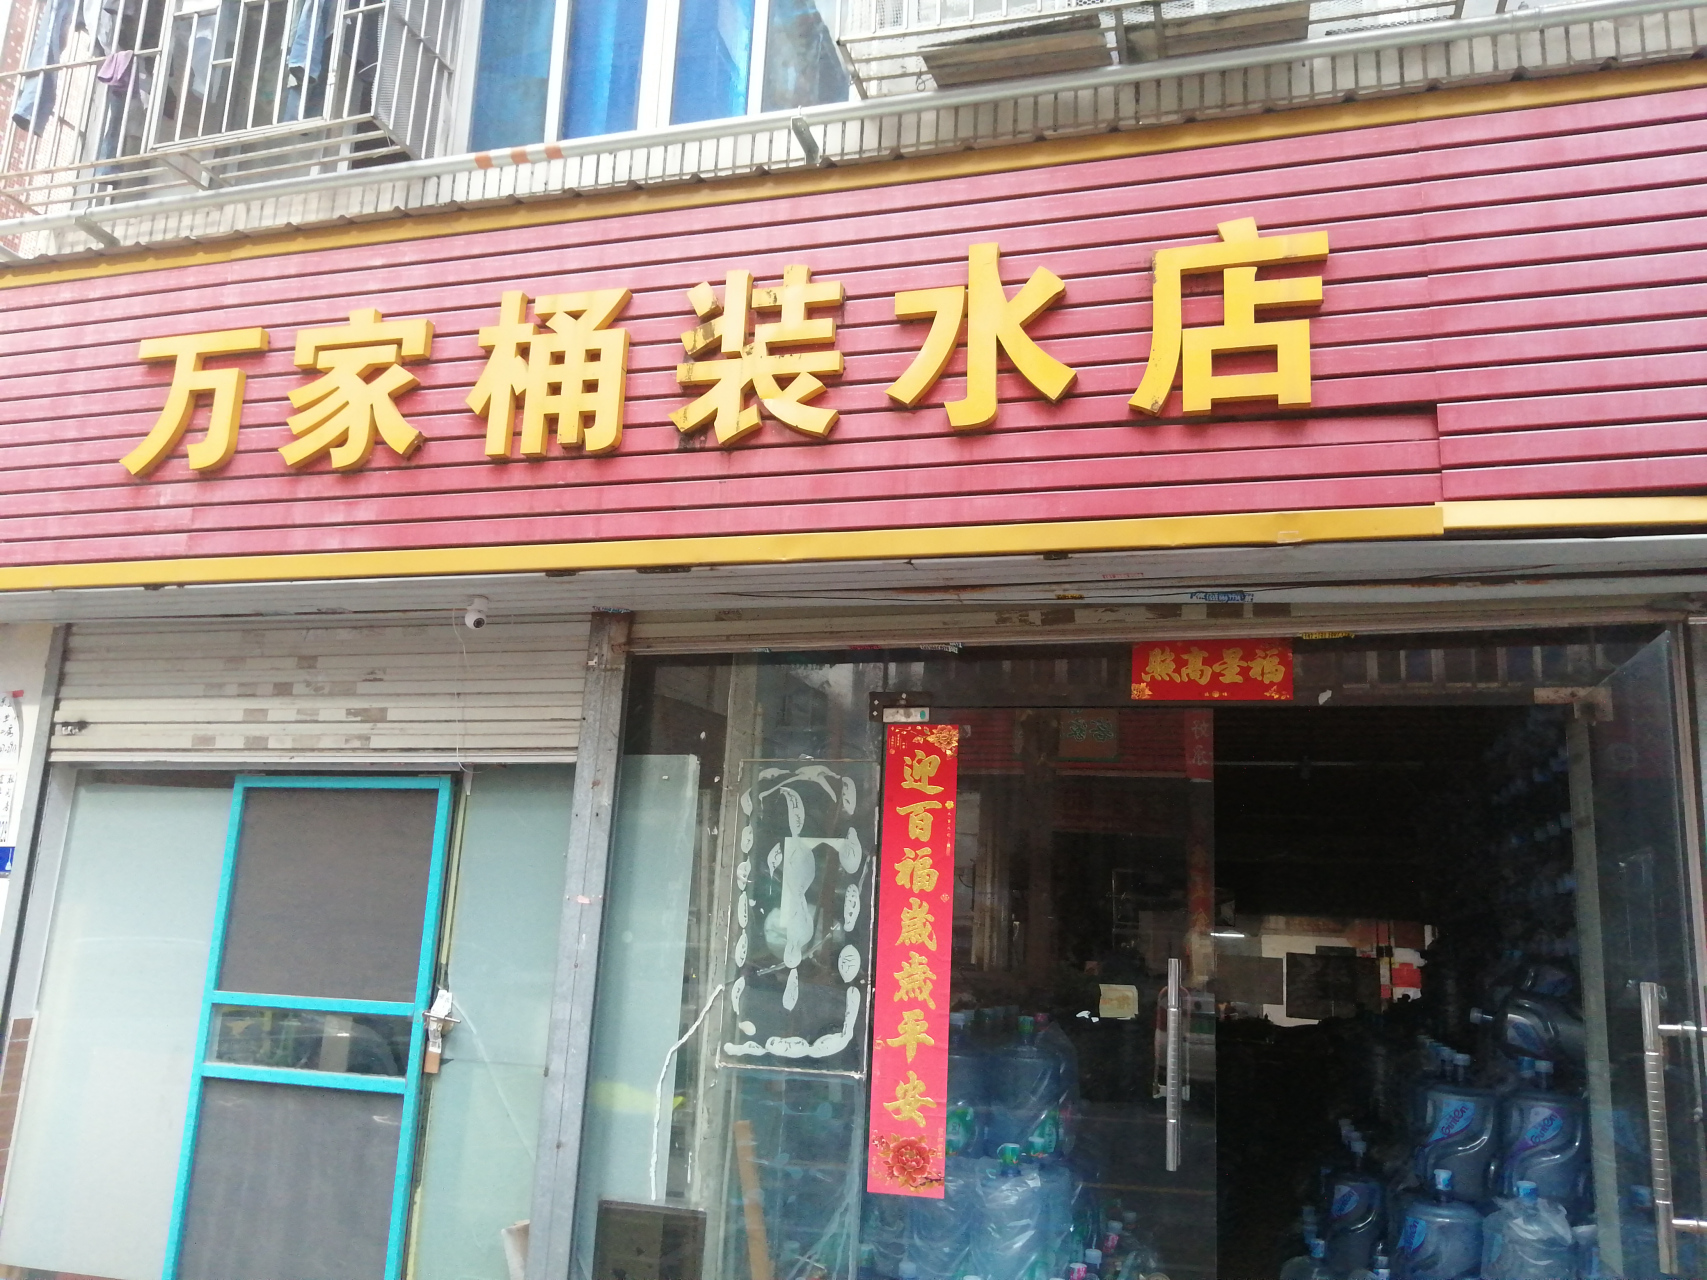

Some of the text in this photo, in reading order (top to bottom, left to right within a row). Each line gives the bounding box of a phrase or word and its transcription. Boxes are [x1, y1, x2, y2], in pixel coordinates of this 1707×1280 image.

[118, 218, 1331, 476] 万家桶装水店
